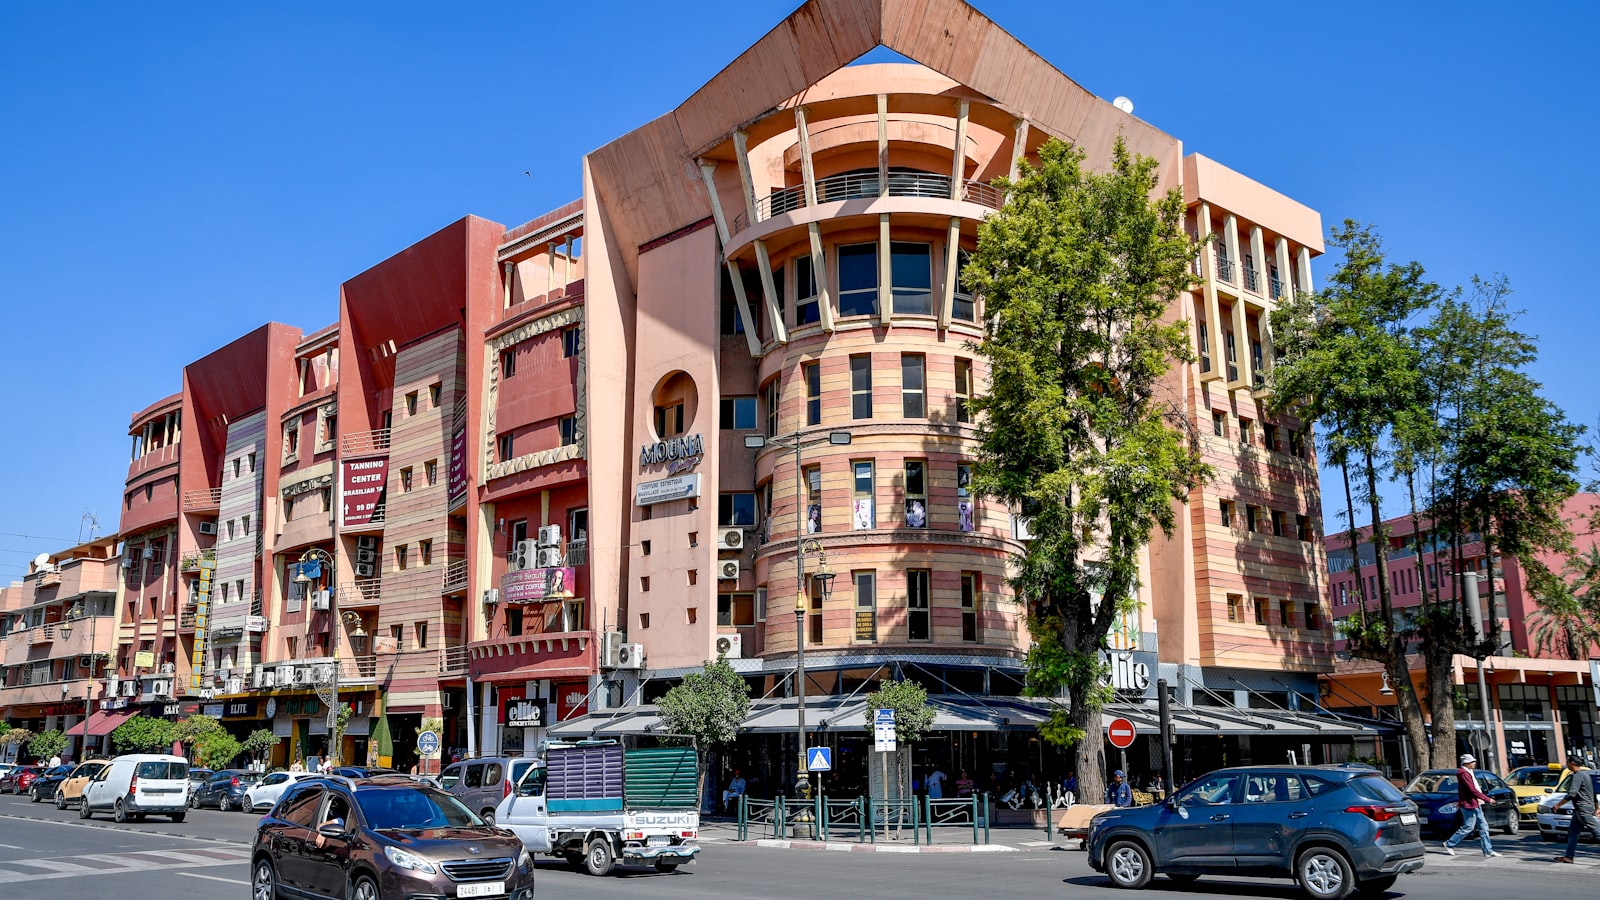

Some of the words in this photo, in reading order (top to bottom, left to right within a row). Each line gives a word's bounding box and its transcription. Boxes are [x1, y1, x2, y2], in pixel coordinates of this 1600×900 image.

[641, 434, 705, 466] MOUNA
[350, 461, 384, 470] TANNING
[351, 474, 381, 483] CENTER
[343, 488, 375, 497] BRASILIAN
[1098, 652, 1150, 690] elite
[566, 692, 586, 704] elite
[230, 703, 248, 714] ELITE
[509, 700, 541, 721] elite
[635, 816, 690, 825] SUZUKI
